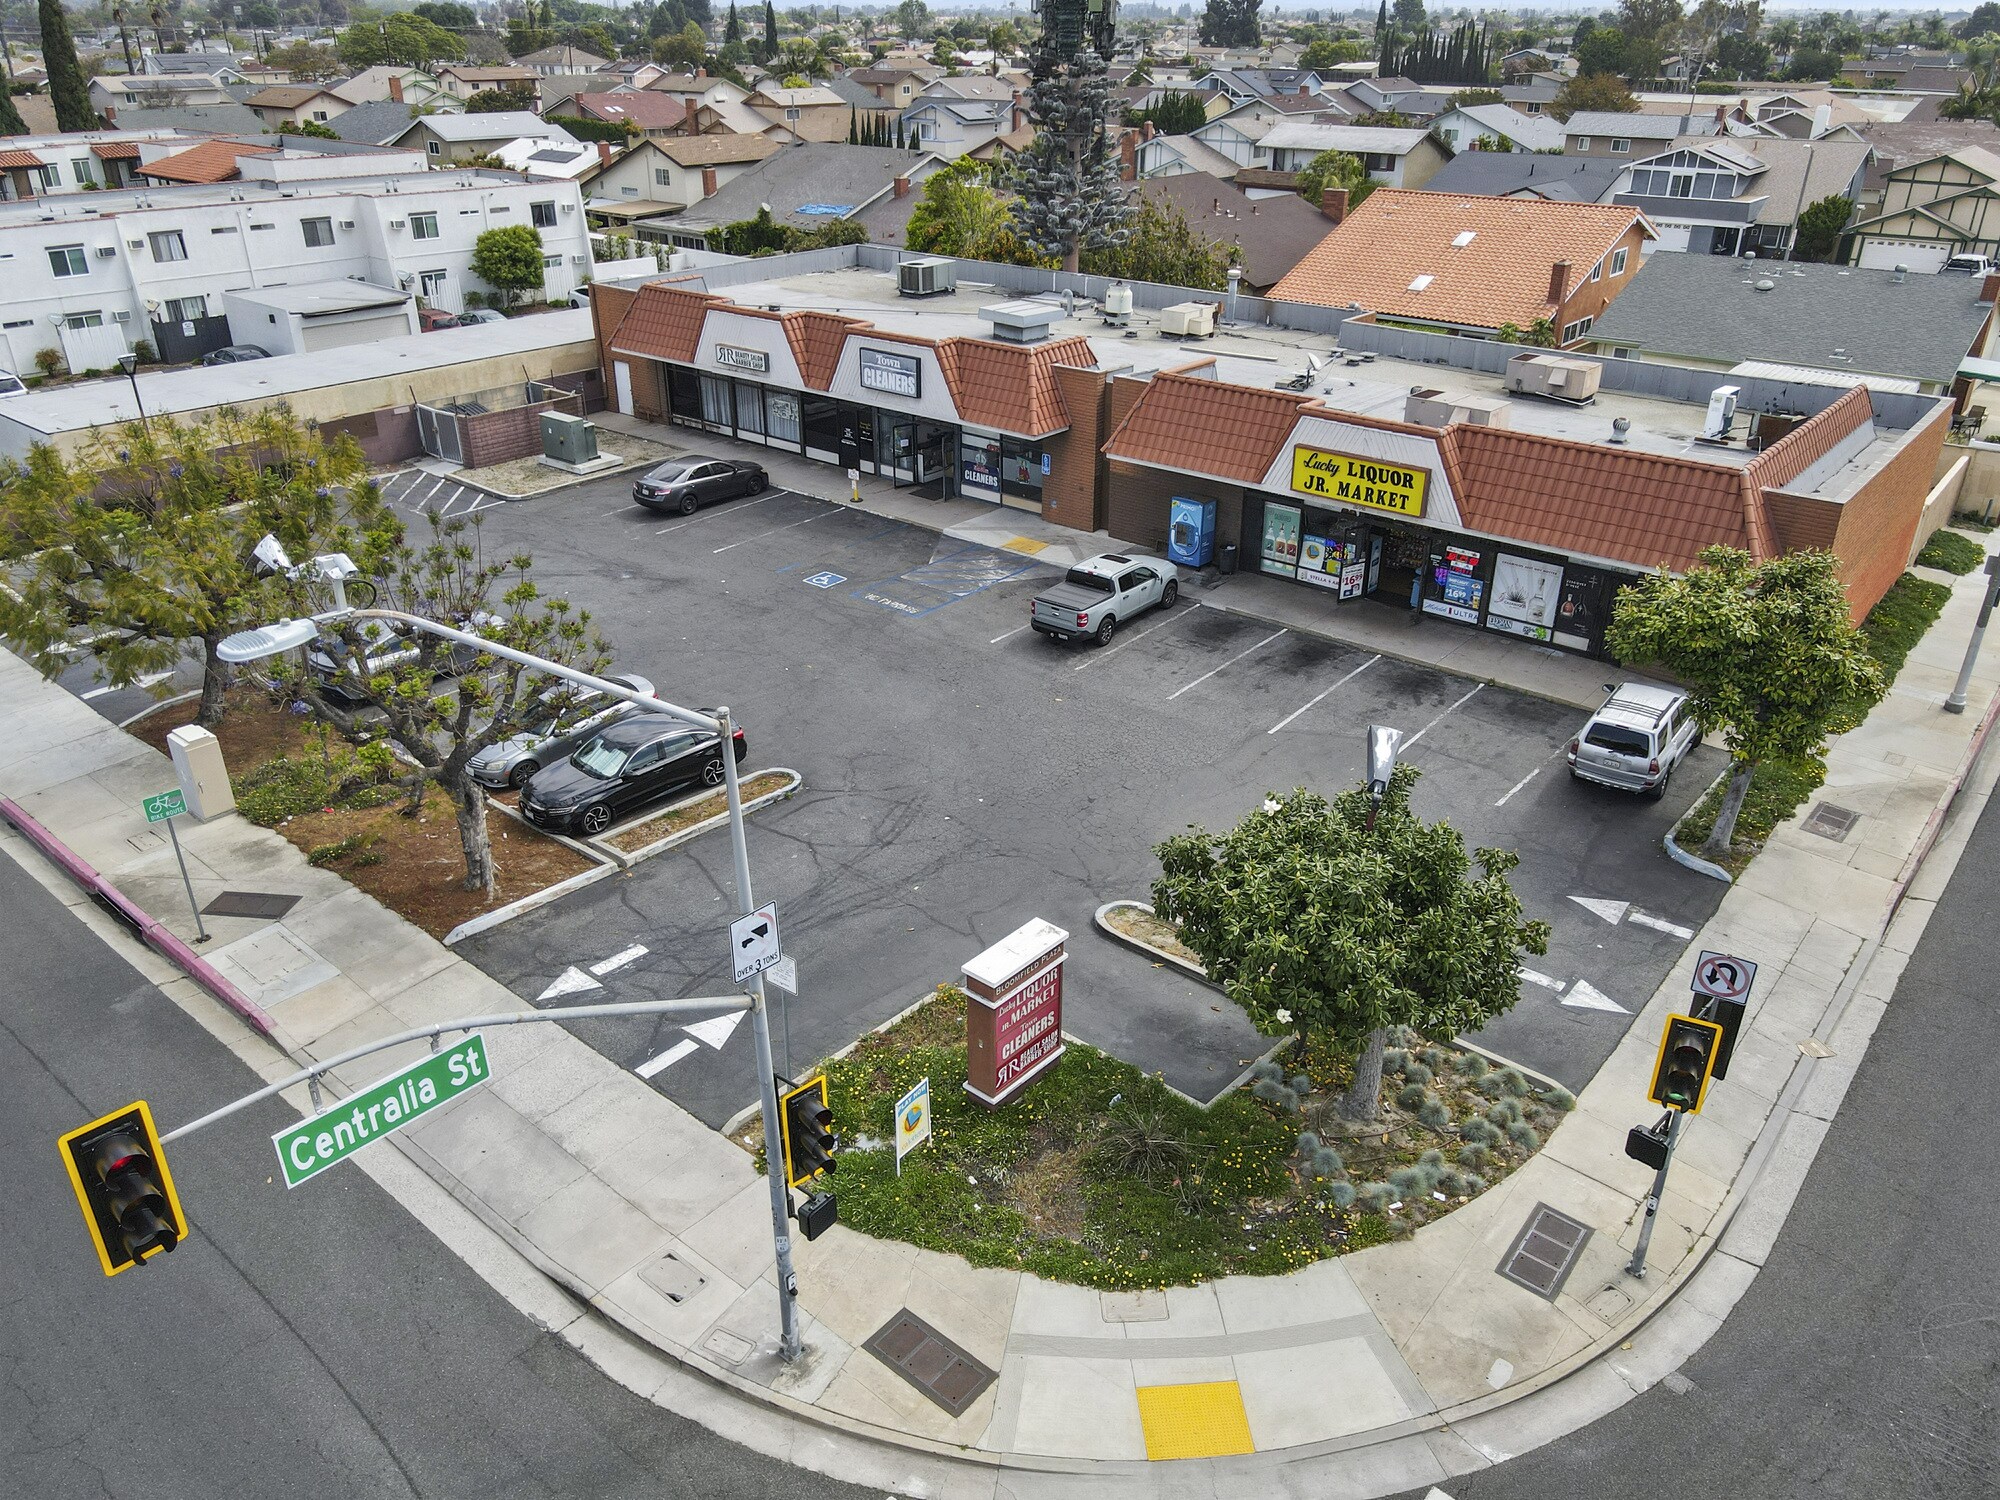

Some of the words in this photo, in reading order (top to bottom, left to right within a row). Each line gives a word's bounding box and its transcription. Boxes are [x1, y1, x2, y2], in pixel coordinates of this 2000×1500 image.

[875, 354, 901, 368] Town
[864, 367, 915, 394] CLEANERS
[964, 469, 998, 487] CLEANERS
[1303, 452, 1340, 478] Lucky
[1347, 461, 1414, 489] LIQUOR
[1304, 475, 1329, 493] JR.
[1336, 481, 1409, 510] MARKET
[150, 812, 163, 821] BIKE
[166, 806, 183, 816] ROUTE
[737, 964, 753, 978] OVER
[755, 958, 762, 971] 3
[763, 951, 778, 965] TONS
[995, 961, 1039, 995] BLOOMFIELD
[1041, 946, 1061, 963] PLAZA
[1016, 967, 1058, 1006] LIQUOR
[1001, 1021, 1012, 1033] JR.
[1011, 982, 1056, 1024] MARKET
[1002, 1010, 1055, 1060] CLEANERS
[1020, 1016, 1038, 1032] Town
[1020, 1041, 1041, 1061] BEAUTY
[1020, 1050, 1042, 1070] BARBER
[290, 1077, 437, 1171] Centralia
[447, 1046, 482, 1087] St
